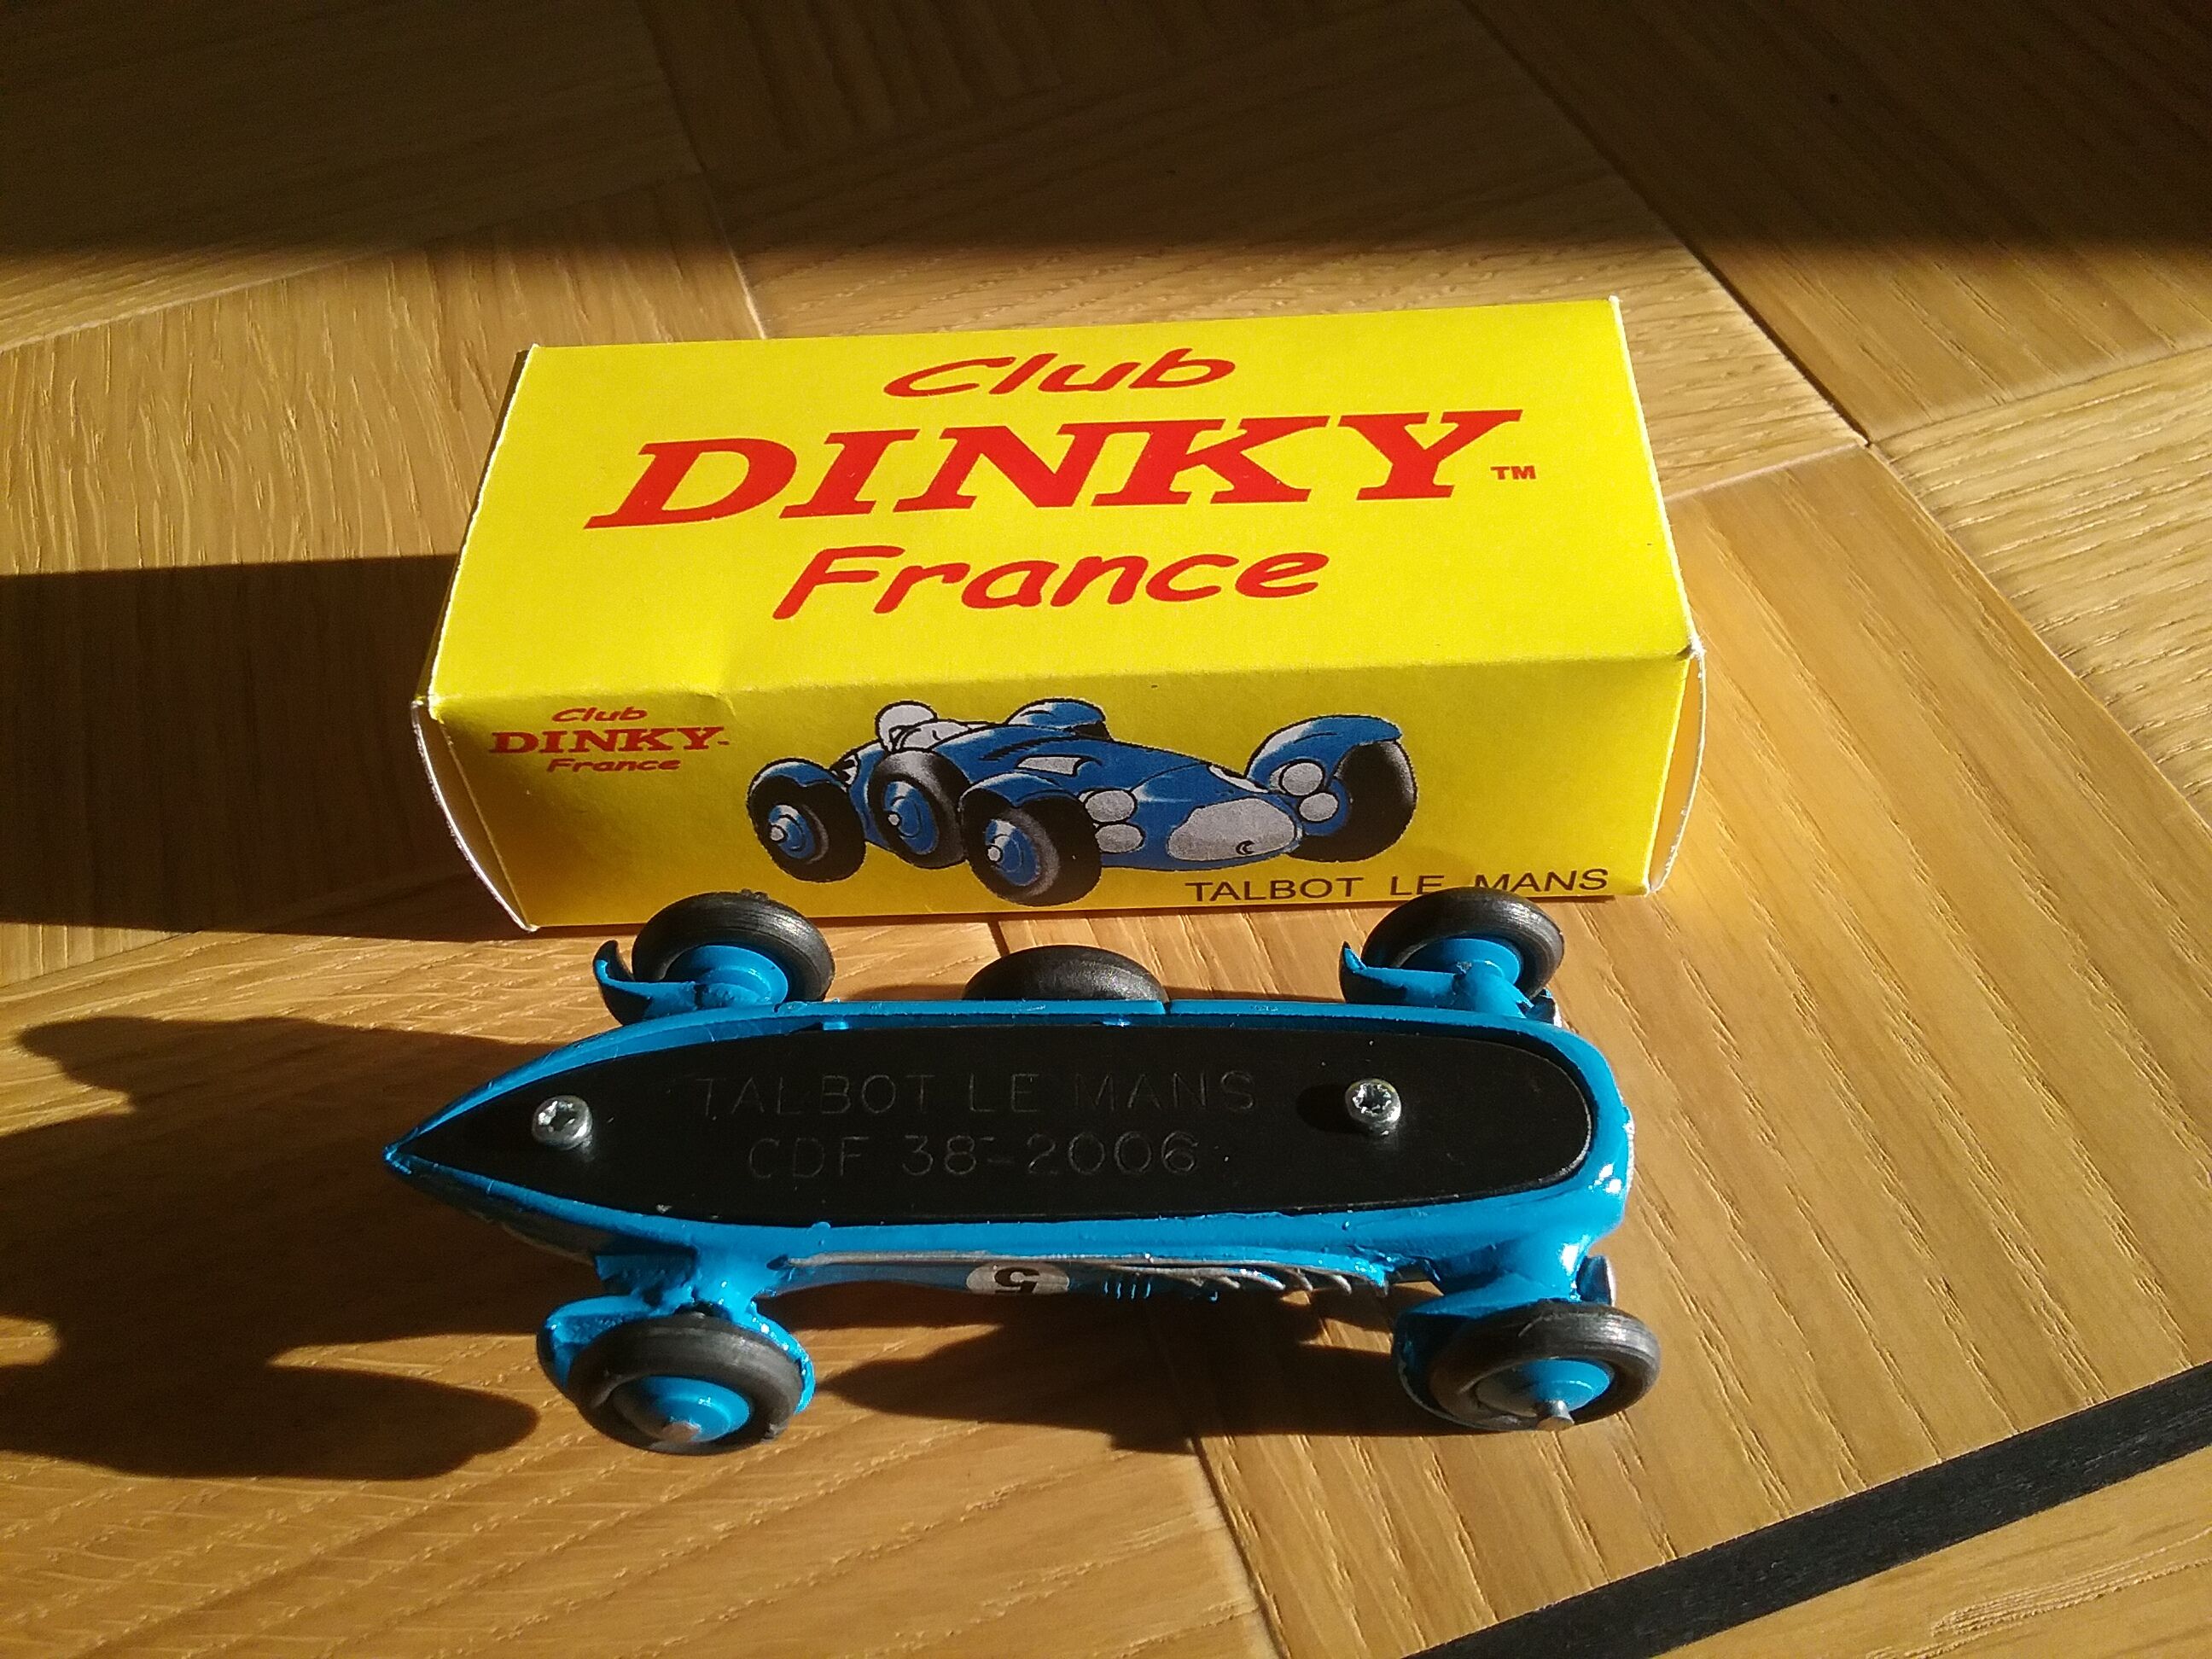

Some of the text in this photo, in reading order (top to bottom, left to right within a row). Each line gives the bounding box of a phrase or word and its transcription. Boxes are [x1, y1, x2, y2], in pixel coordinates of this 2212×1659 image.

[882, 346, 1237, 399] Club
[583, 409, 1522, 530] DINKY
[772, 544, 1330, 620] France
[551, 707, 649, 723] Club
[488, 725, 725, 754] DINKY
[546, 757, 682, 774] France
[1185, 867, 1609, 903] TALBOT LE MANS
[696, 1069, 1257, 1117] TALBOT LE MANS
[747, 1135, 870, 1180] CDF
